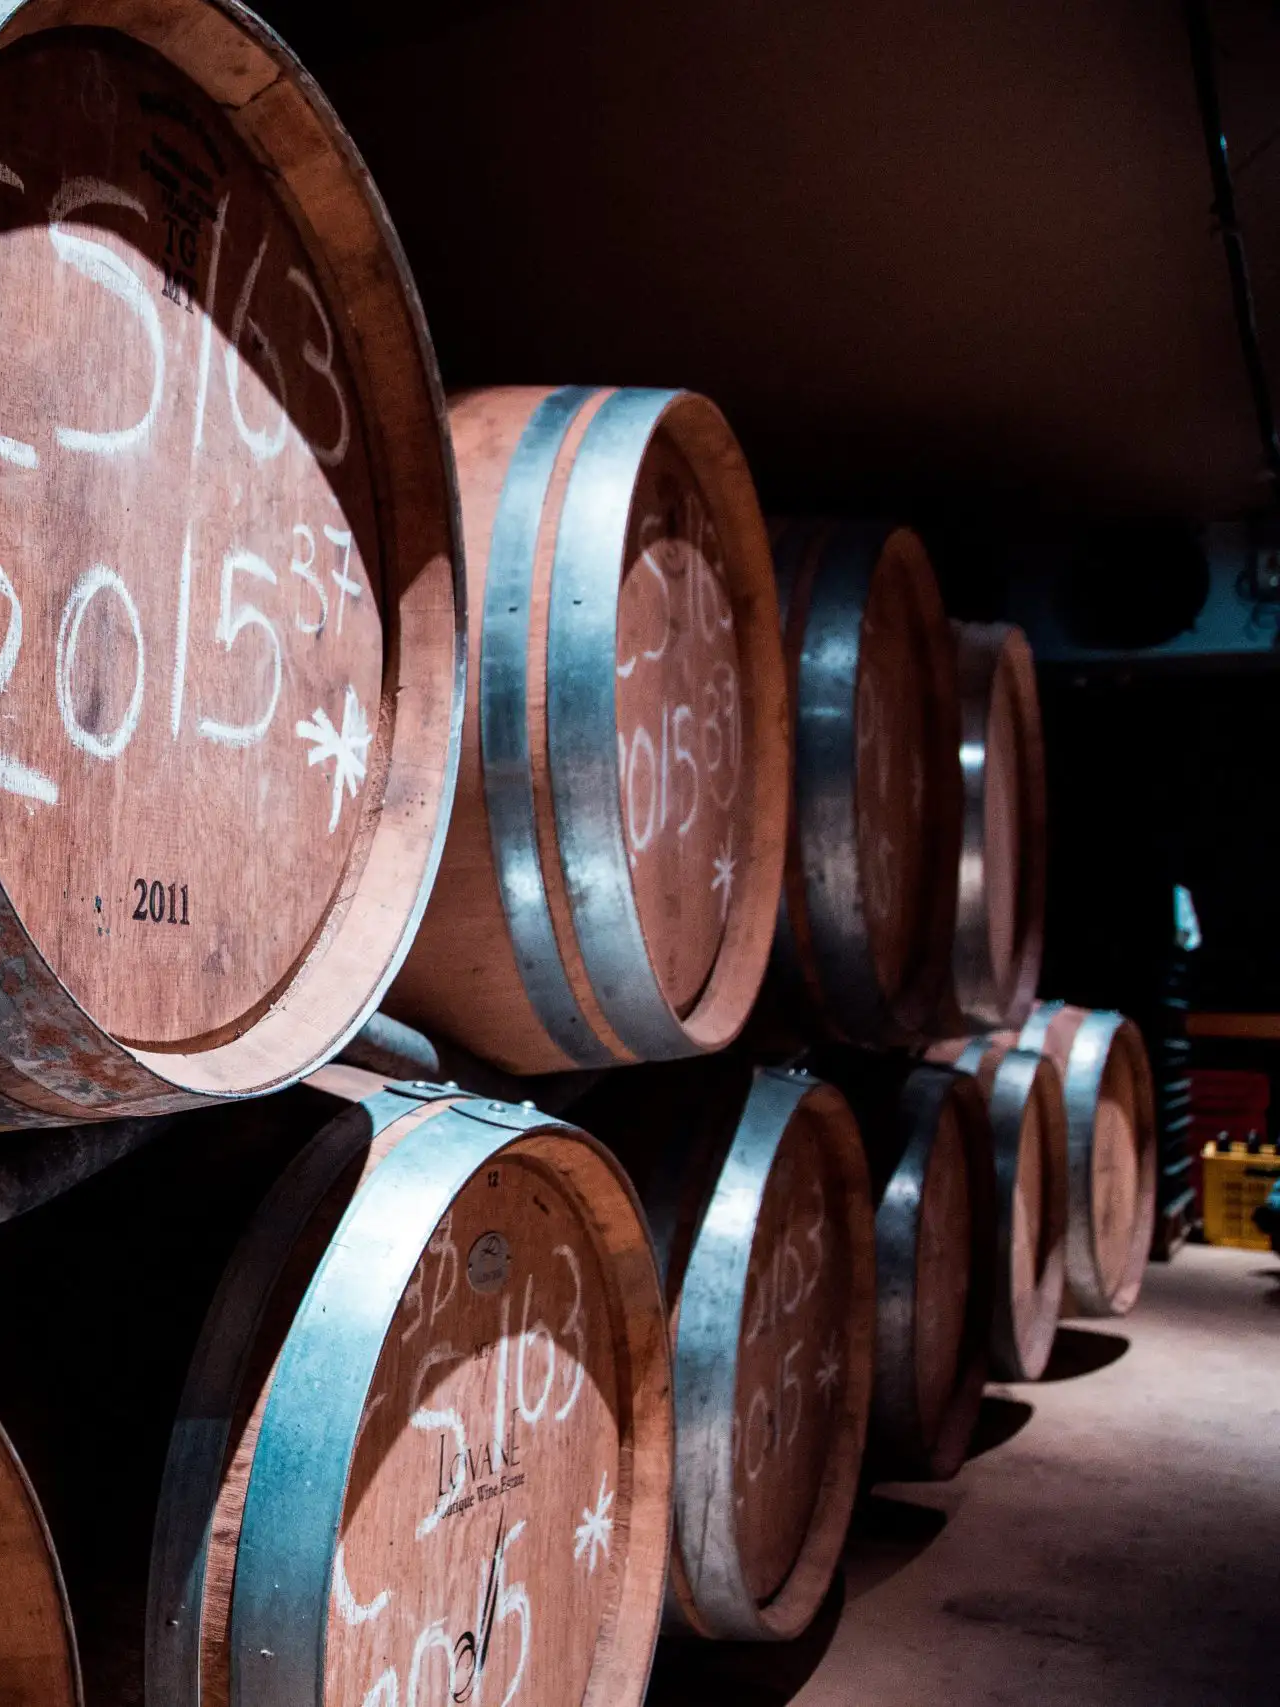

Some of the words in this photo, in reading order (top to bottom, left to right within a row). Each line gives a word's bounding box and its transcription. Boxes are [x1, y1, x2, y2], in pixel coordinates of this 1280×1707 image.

[290, 522, 363, 636] 37
[132, 878, 190, 926] 2011
[732, 1340, 803, 1507] 015
[435, 1493, 476, 1520] utique
